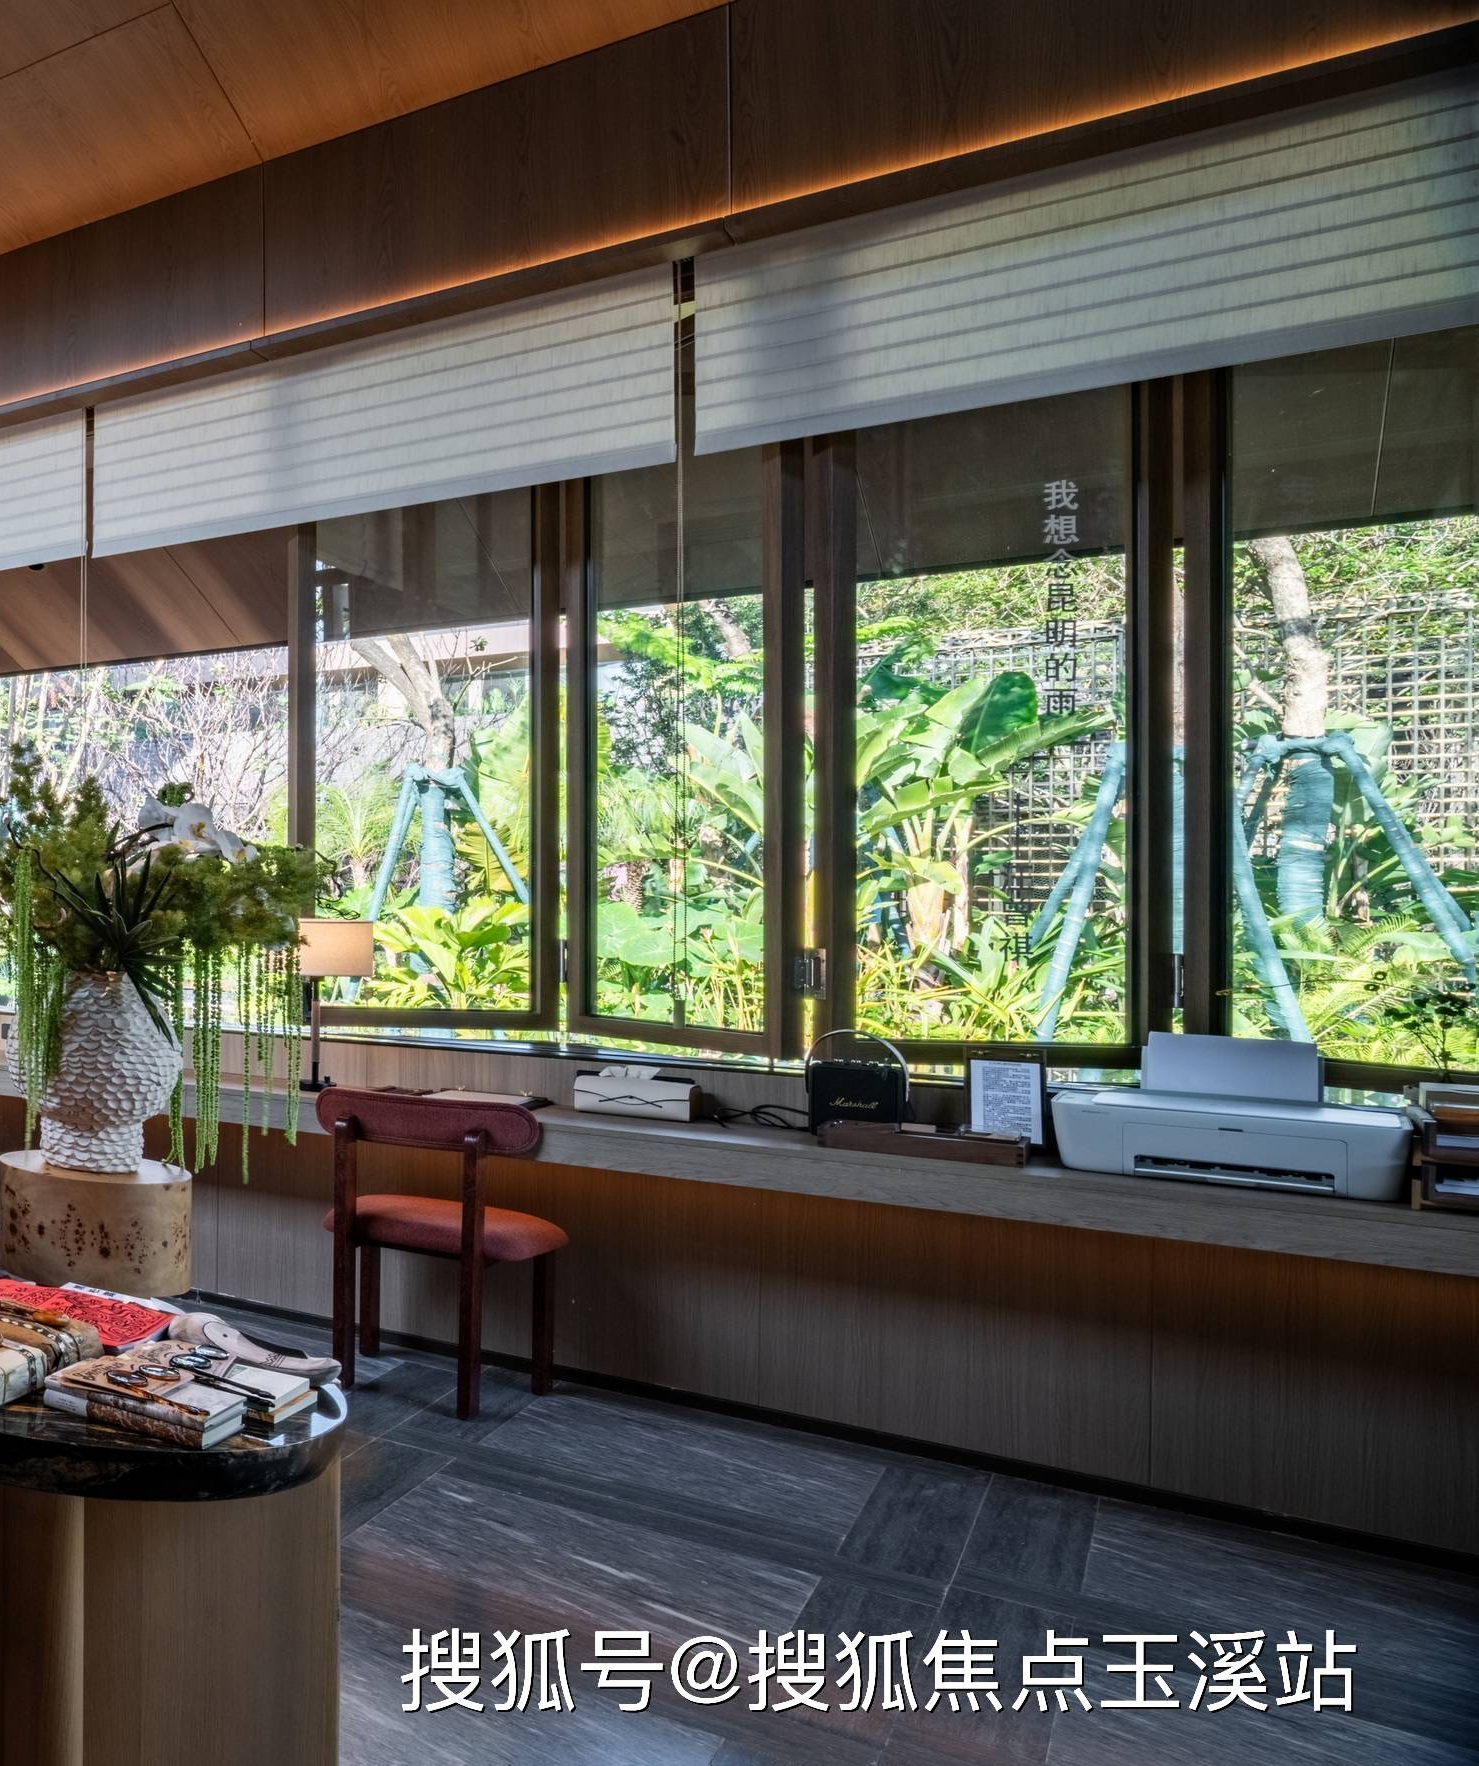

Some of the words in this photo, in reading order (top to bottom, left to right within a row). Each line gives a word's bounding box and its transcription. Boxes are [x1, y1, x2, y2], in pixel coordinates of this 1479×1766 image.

[1043, 480, 1079, 715] 我想念昆明的雨
[829, 1097, 879, 1110] Marshall
